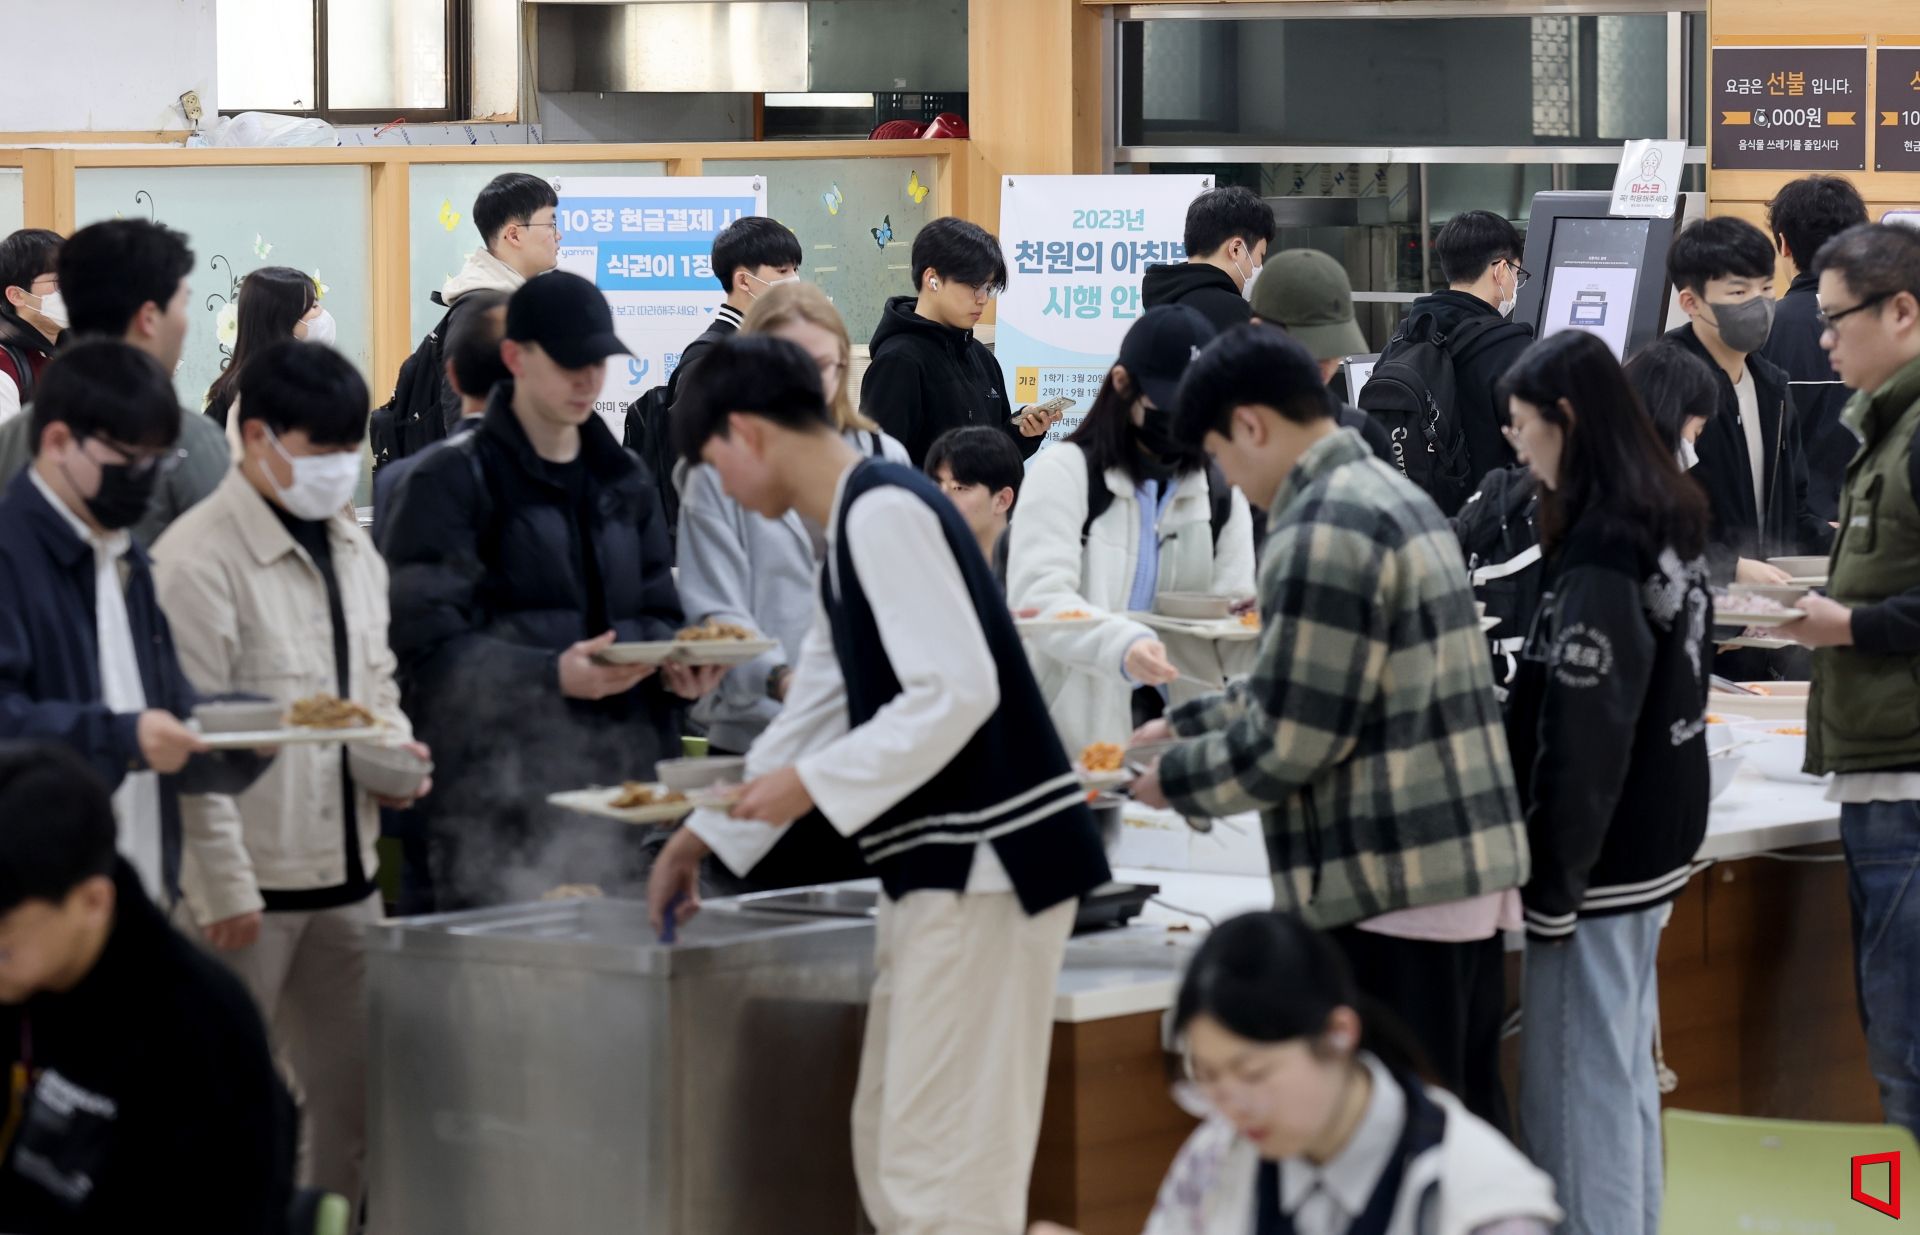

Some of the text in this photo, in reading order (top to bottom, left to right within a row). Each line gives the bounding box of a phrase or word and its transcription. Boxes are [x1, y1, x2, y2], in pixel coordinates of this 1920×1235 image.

[1725, 71, 1853, 96] 요금은 선불 입니다.
[1738, 139, 1839, 151] 음식물 쓰레기를 줄입시다
[1631, 183, 1660, 194] 마스크
[561, 208, 615, 233] 10장
[619, 208, 714, 233] 현금결제
[1072, 208, 1145, 232] 2023년
[561, 247, 595, 258] yammi
[1014, 240, 1104, 275] 천원의
[607, 254, 674, 279] 식권이
[1042, 285, 1145, 319] 시행 안
[616, 306, 636, 316] 보고
[637, 305, 698, 316] 따라해주세요!
[1043, 374, 1064, 383] 1학기
[1071, 374, 1085, 383] 3월
[1042, 388, 1064, 396] 2학기
[1071, 388, 1085, 397] 9월
[595, 401, 616, 413] 야미
